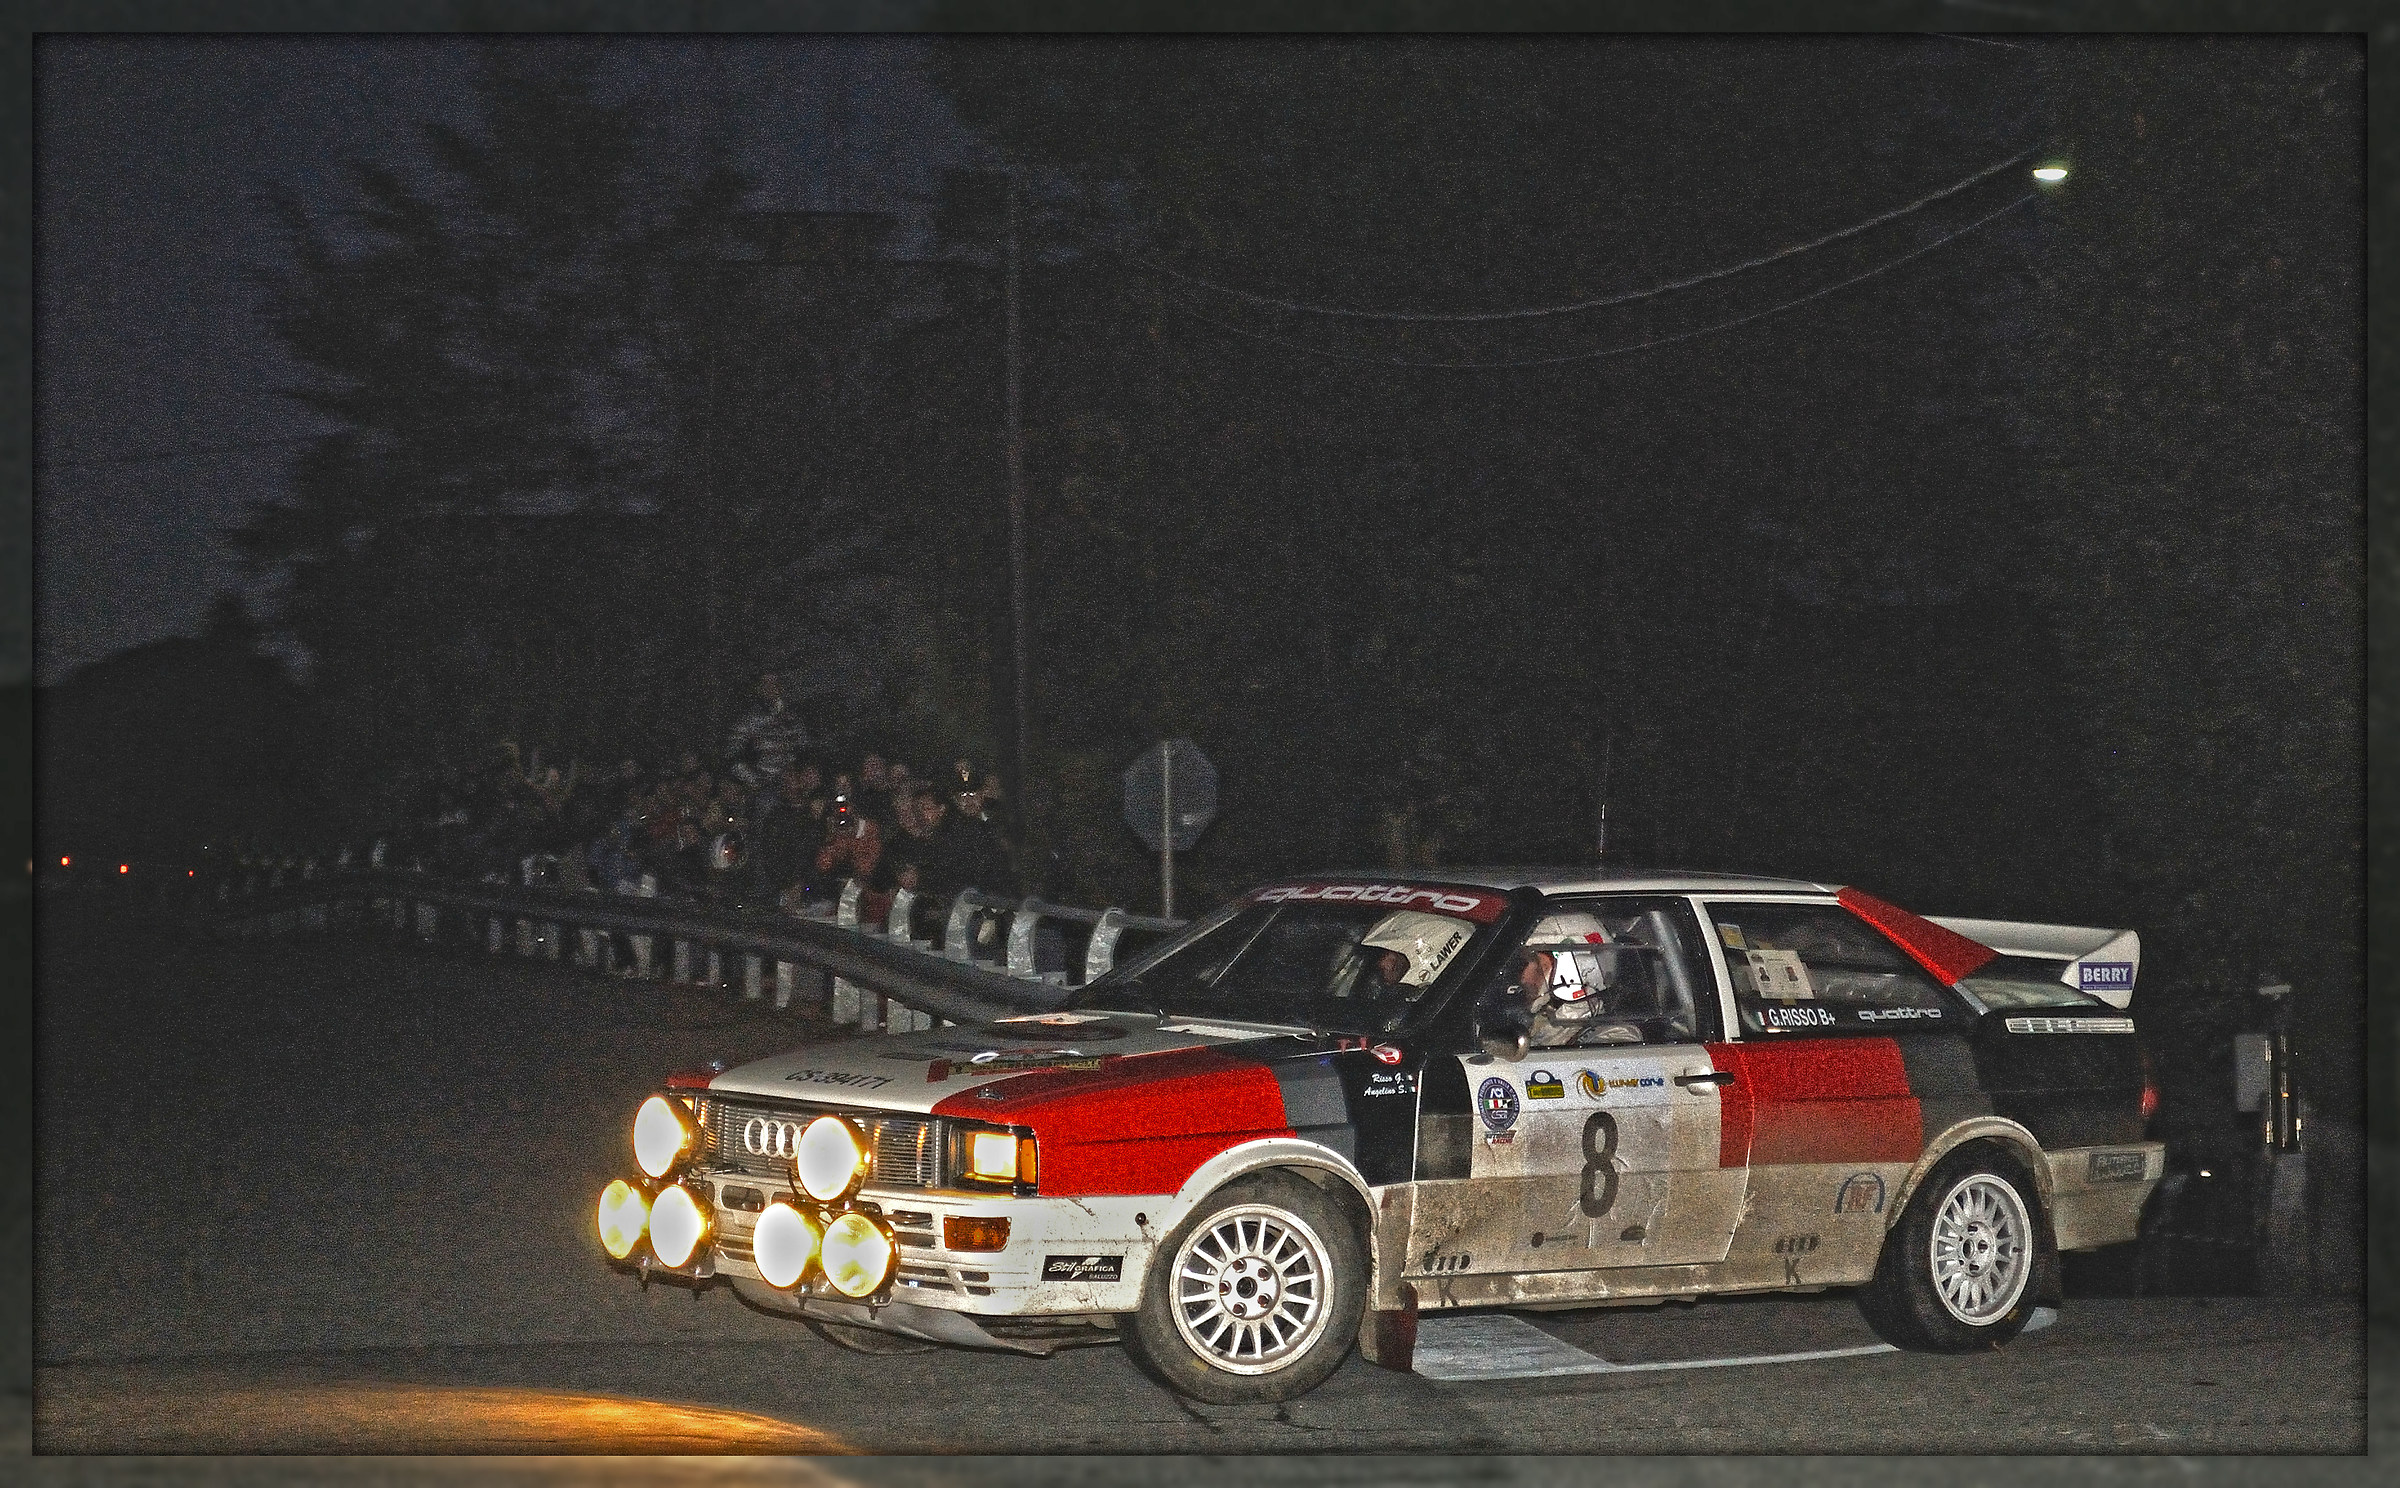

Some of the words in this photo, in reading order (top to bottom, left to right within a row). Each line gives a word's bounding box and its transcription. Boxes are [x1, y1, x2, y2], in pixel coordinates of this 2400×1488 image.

[1256, 884, 1481, 912] quattro
[1430, 931, 1462, 971] LAWER
[2083, 967, 2129, 982] BERRY
[1768, 1008, 1817, 1027] G.RISSO
[1817, 1008, 1836, 1026] B+
[1858, 1007, 1942, 1022] quattro
[1371, 1073, 1393, 1083] Risso
[1363, 1086, 1396, 1098] Angelino
[1397, 1084, 1408, 1094] S.
[1580, 1111, 1619, 1218] 8
[1074, 1264, 1115, 1273] GRAFICA
[1784, 1258, 1801, 1285] K
